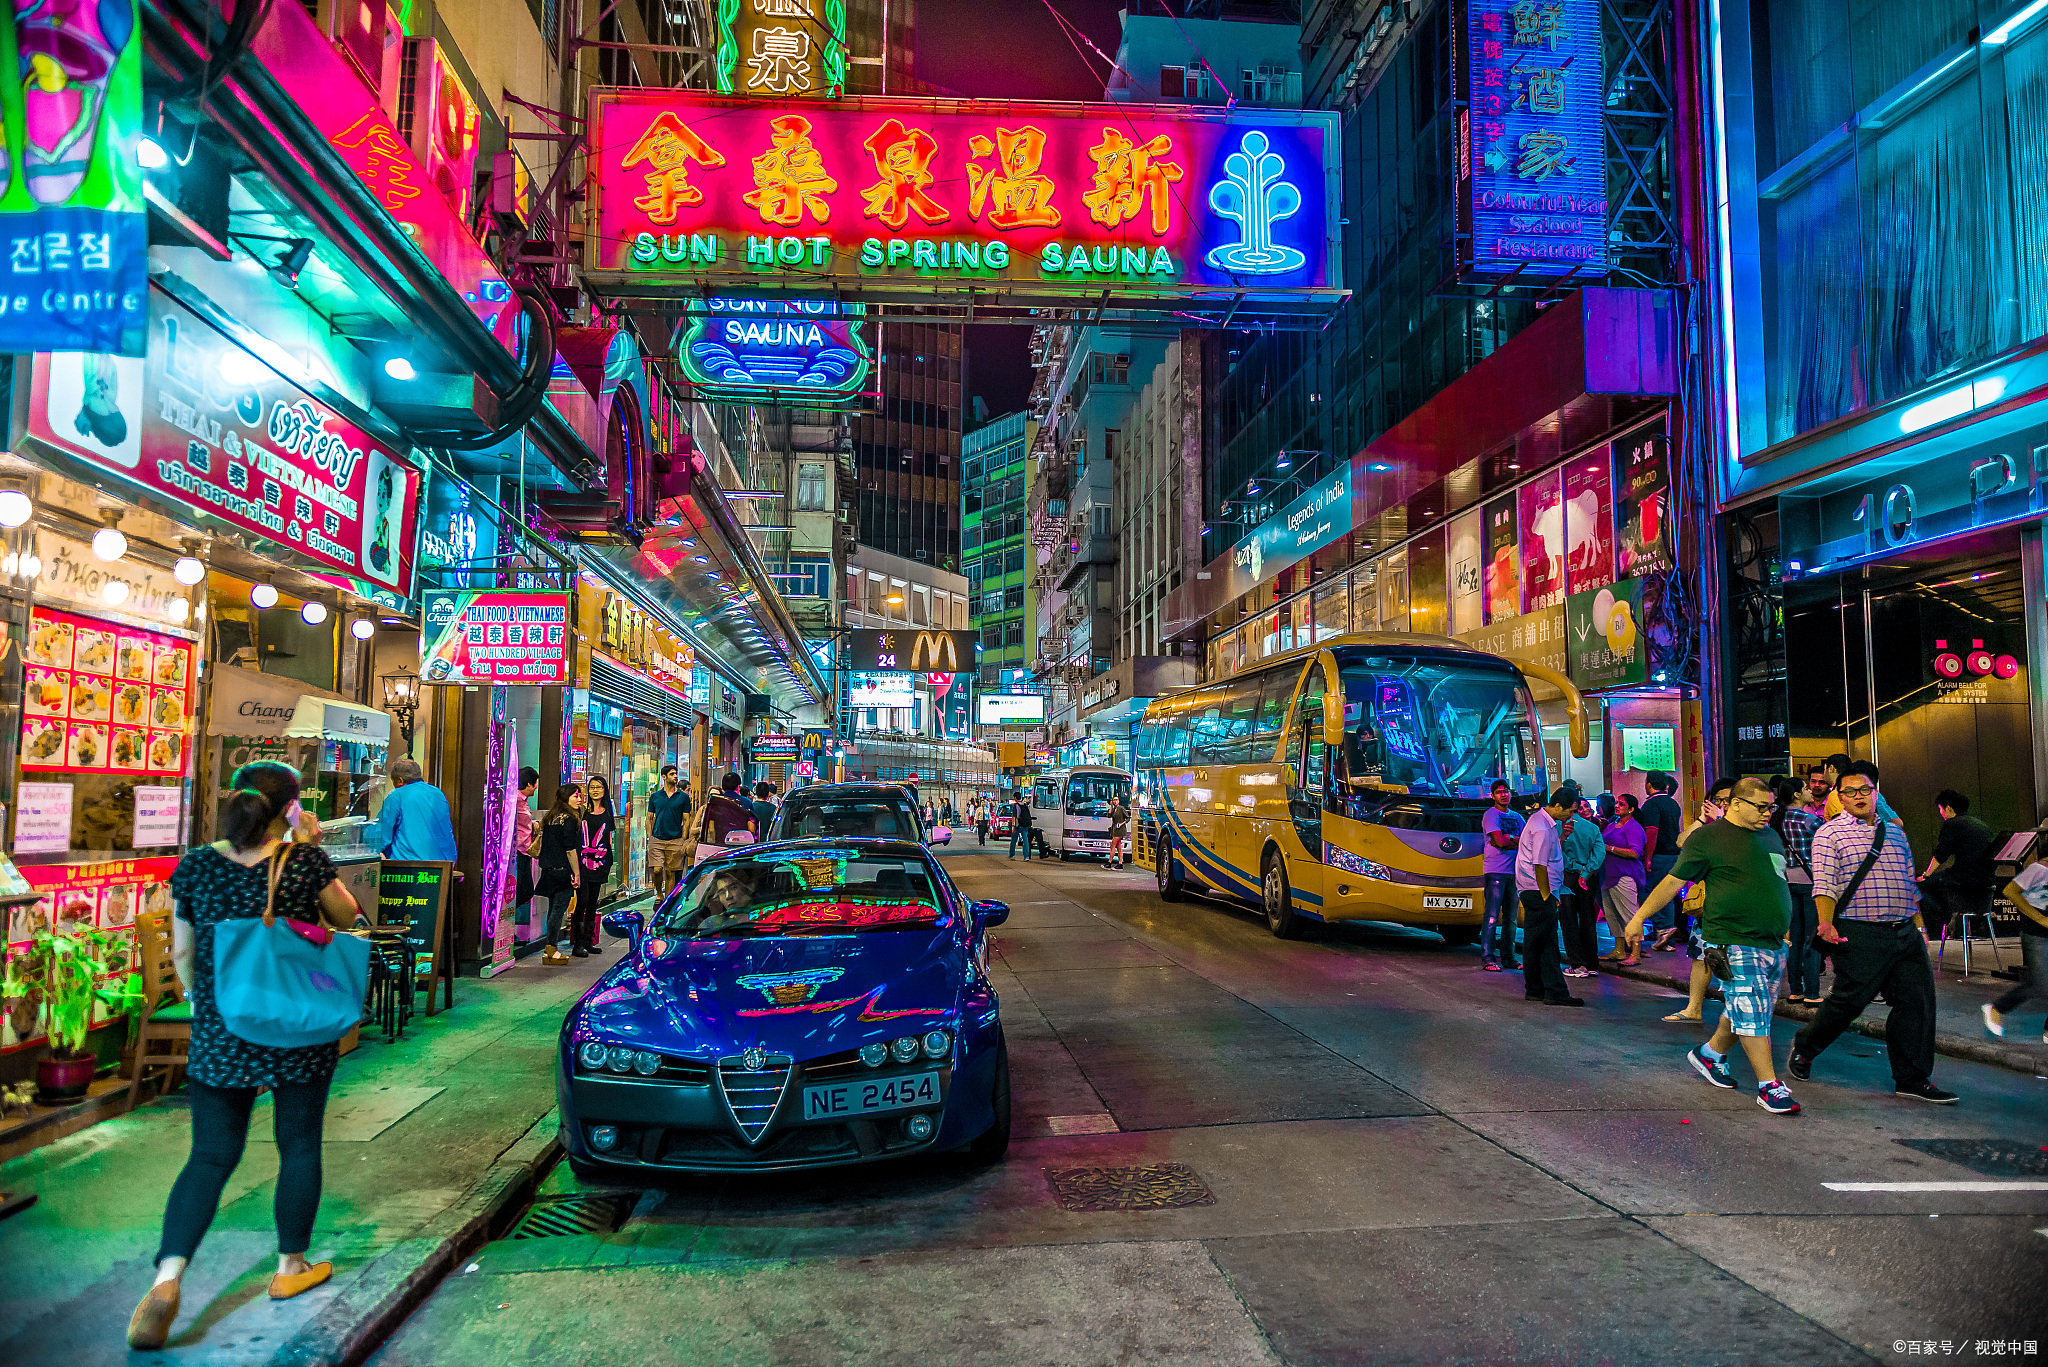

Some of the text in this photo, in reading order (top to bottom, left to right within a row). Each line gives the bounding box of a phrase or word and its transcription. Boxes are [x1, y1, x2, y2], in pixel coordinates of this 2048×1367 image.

[1482, 191, 1607, 214] Colourful Year
[1509, 215, 1582, 234] Seafood
[634, 232, 1175, 275] SUN HOT SPRING SAUNA
[1497, 237, 1596, 259] Restaurant
[42, 288, 139, 312] Centre
[725, 320, 824, 347] SAUNA
[159, 390, 358, 522] THAI & VIETNAMESE
[1287, 480, 1344, 532] Legends of India
[1852, 483, 1917, 553] 10
[287, 520, 302, 542] &
[427, 612, 459, 623] Chang
[466, 606, 565, 622] THAI FOOD & VIETNAMESE
[469, 626, 563, 644] 越泰香辣軒
[469, 647, 562, 659] TWO HUNDRED VILLAGE
[878, 654, 897, 667] 24
[238, 701, 296, 721] Chang
[1768, 723, 1786, 738] 10號
[381, 873, 414, 884] erman
[416, 871, 440, 885] Bar
[1426, 896, 1471, 909] MX 6371
[811, 1077, 933, 1115] NE 2454
